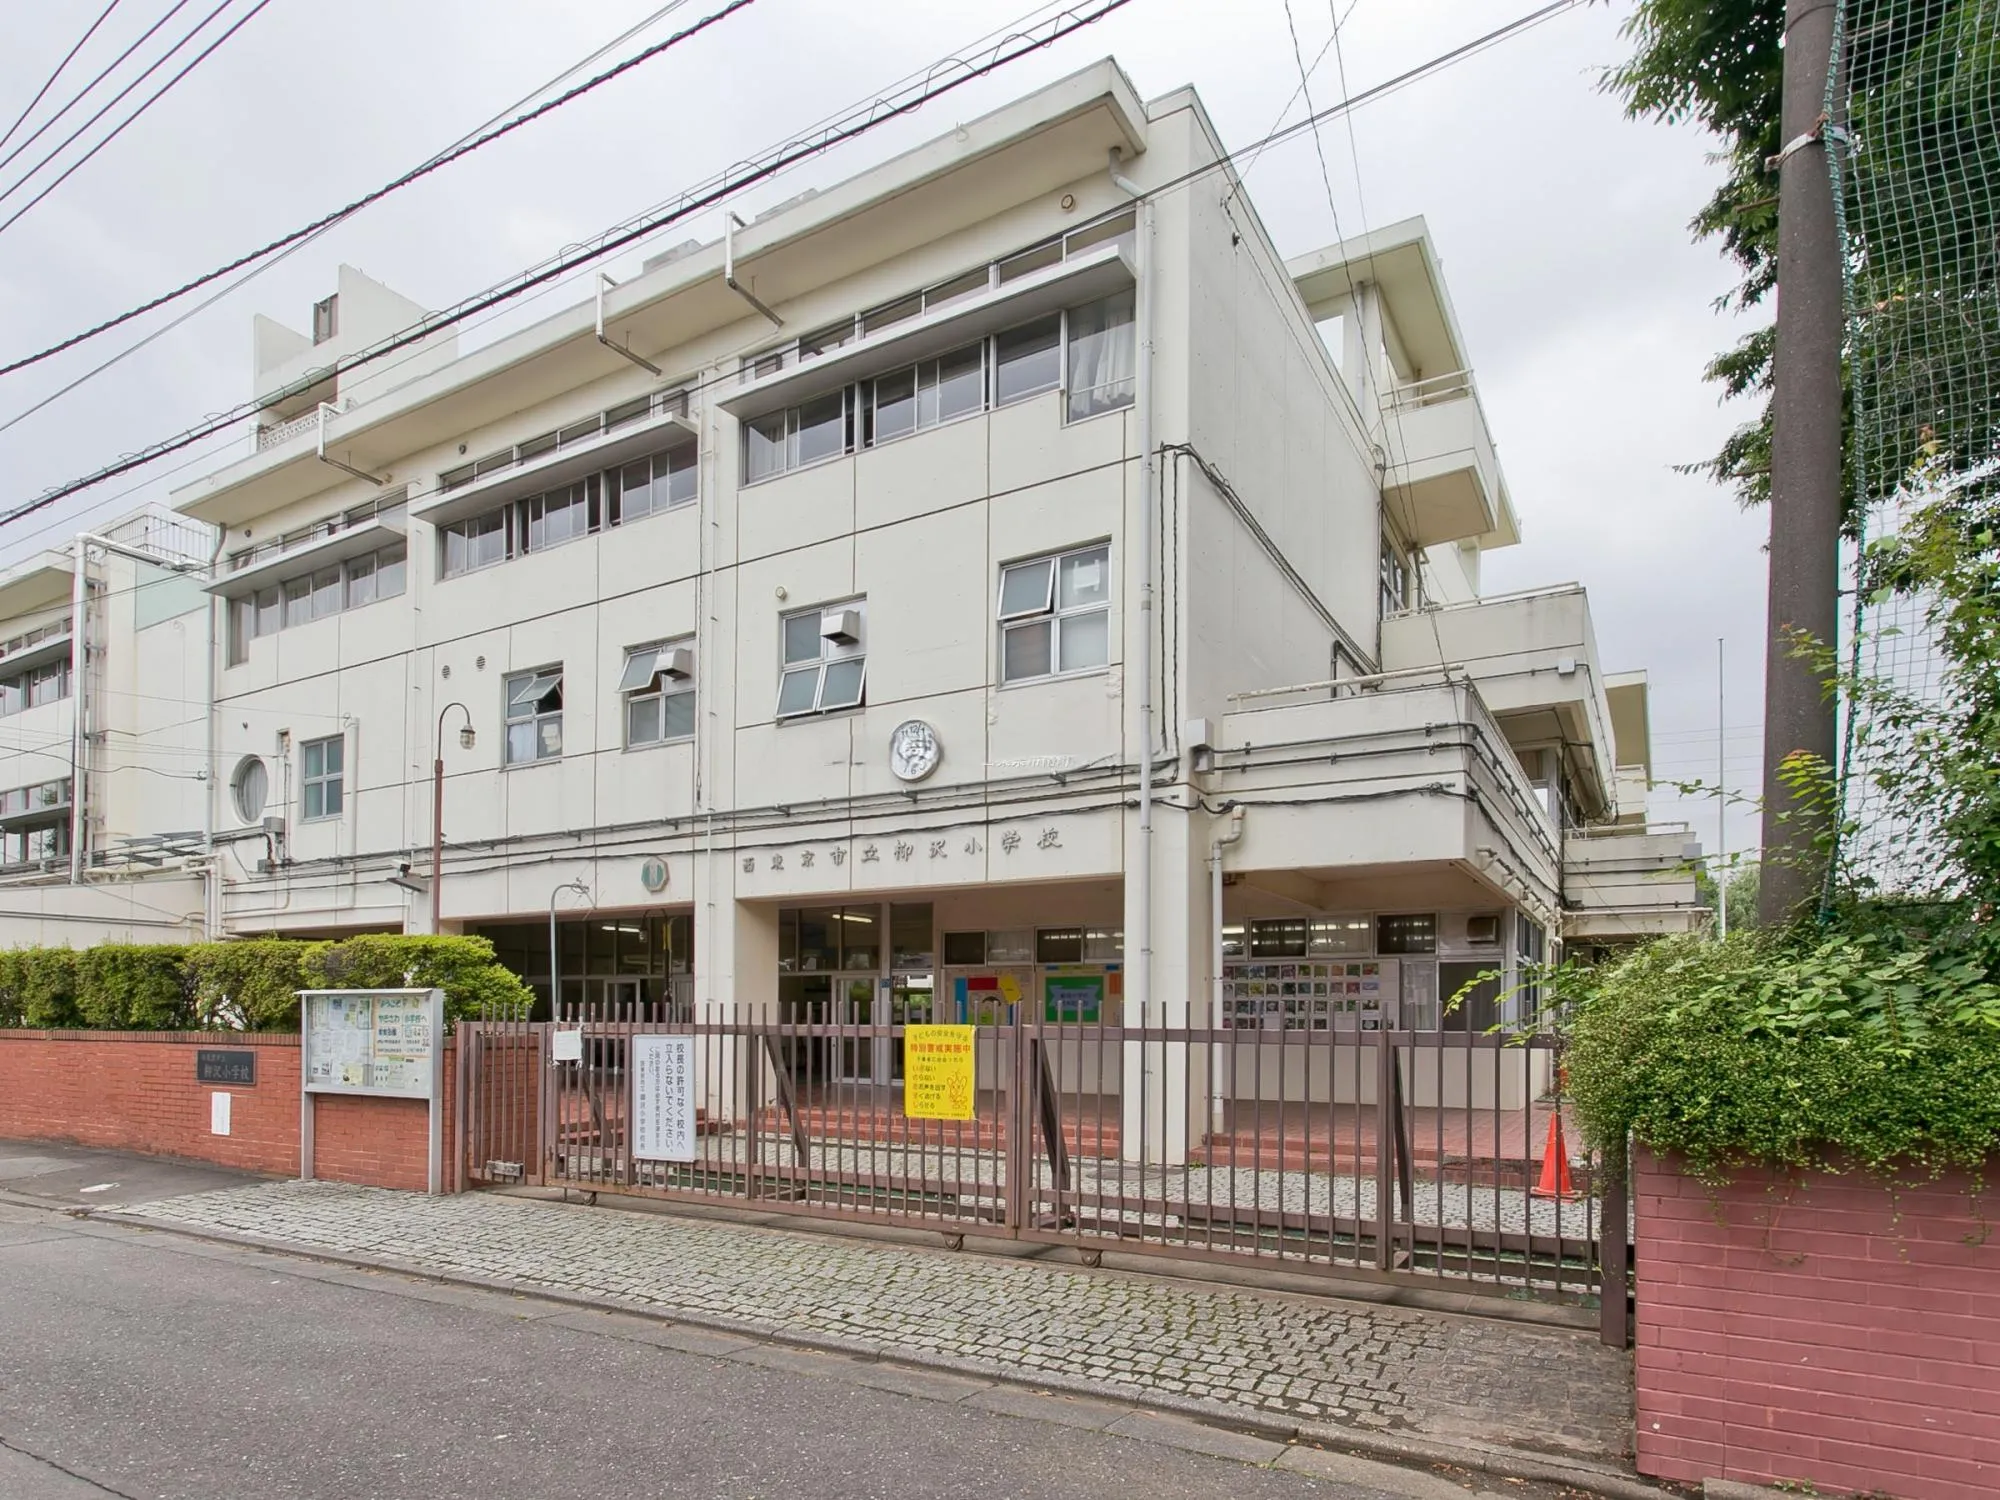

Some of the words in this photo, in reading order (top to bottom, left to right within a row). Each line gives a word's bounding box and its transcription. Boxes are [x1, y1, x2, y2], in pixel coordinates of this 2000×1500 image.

[742, 827, 1064, 874] 西東京市立柳沢小学校
[676, 1043, 686, 1150] 校長の許可なく校内へ
